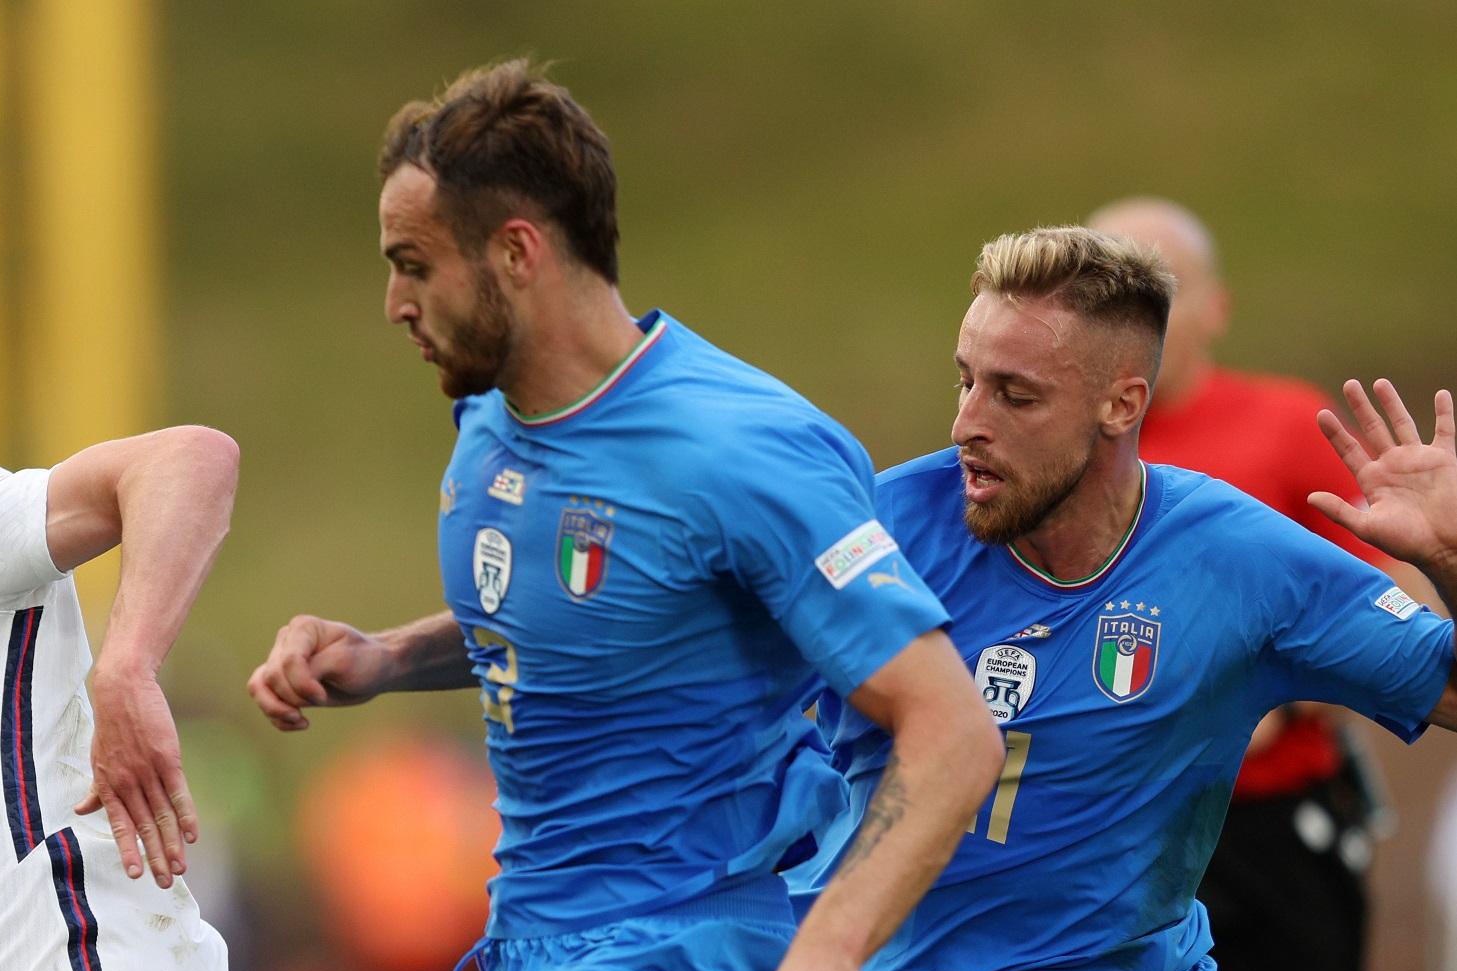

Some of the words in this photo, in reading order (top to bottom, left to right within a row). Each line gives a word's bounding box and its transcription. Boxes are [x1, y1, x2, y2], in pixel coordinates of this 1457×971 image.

[1104, 621, 1154, 640] ITALIA
[997, 649, 1021, 661] UEFA
[987, 658, 1028, 671] EUROPEAN
[985, 665, 1027, 677] CHAMPIONS
[989, 708, 1009, 719] 020
